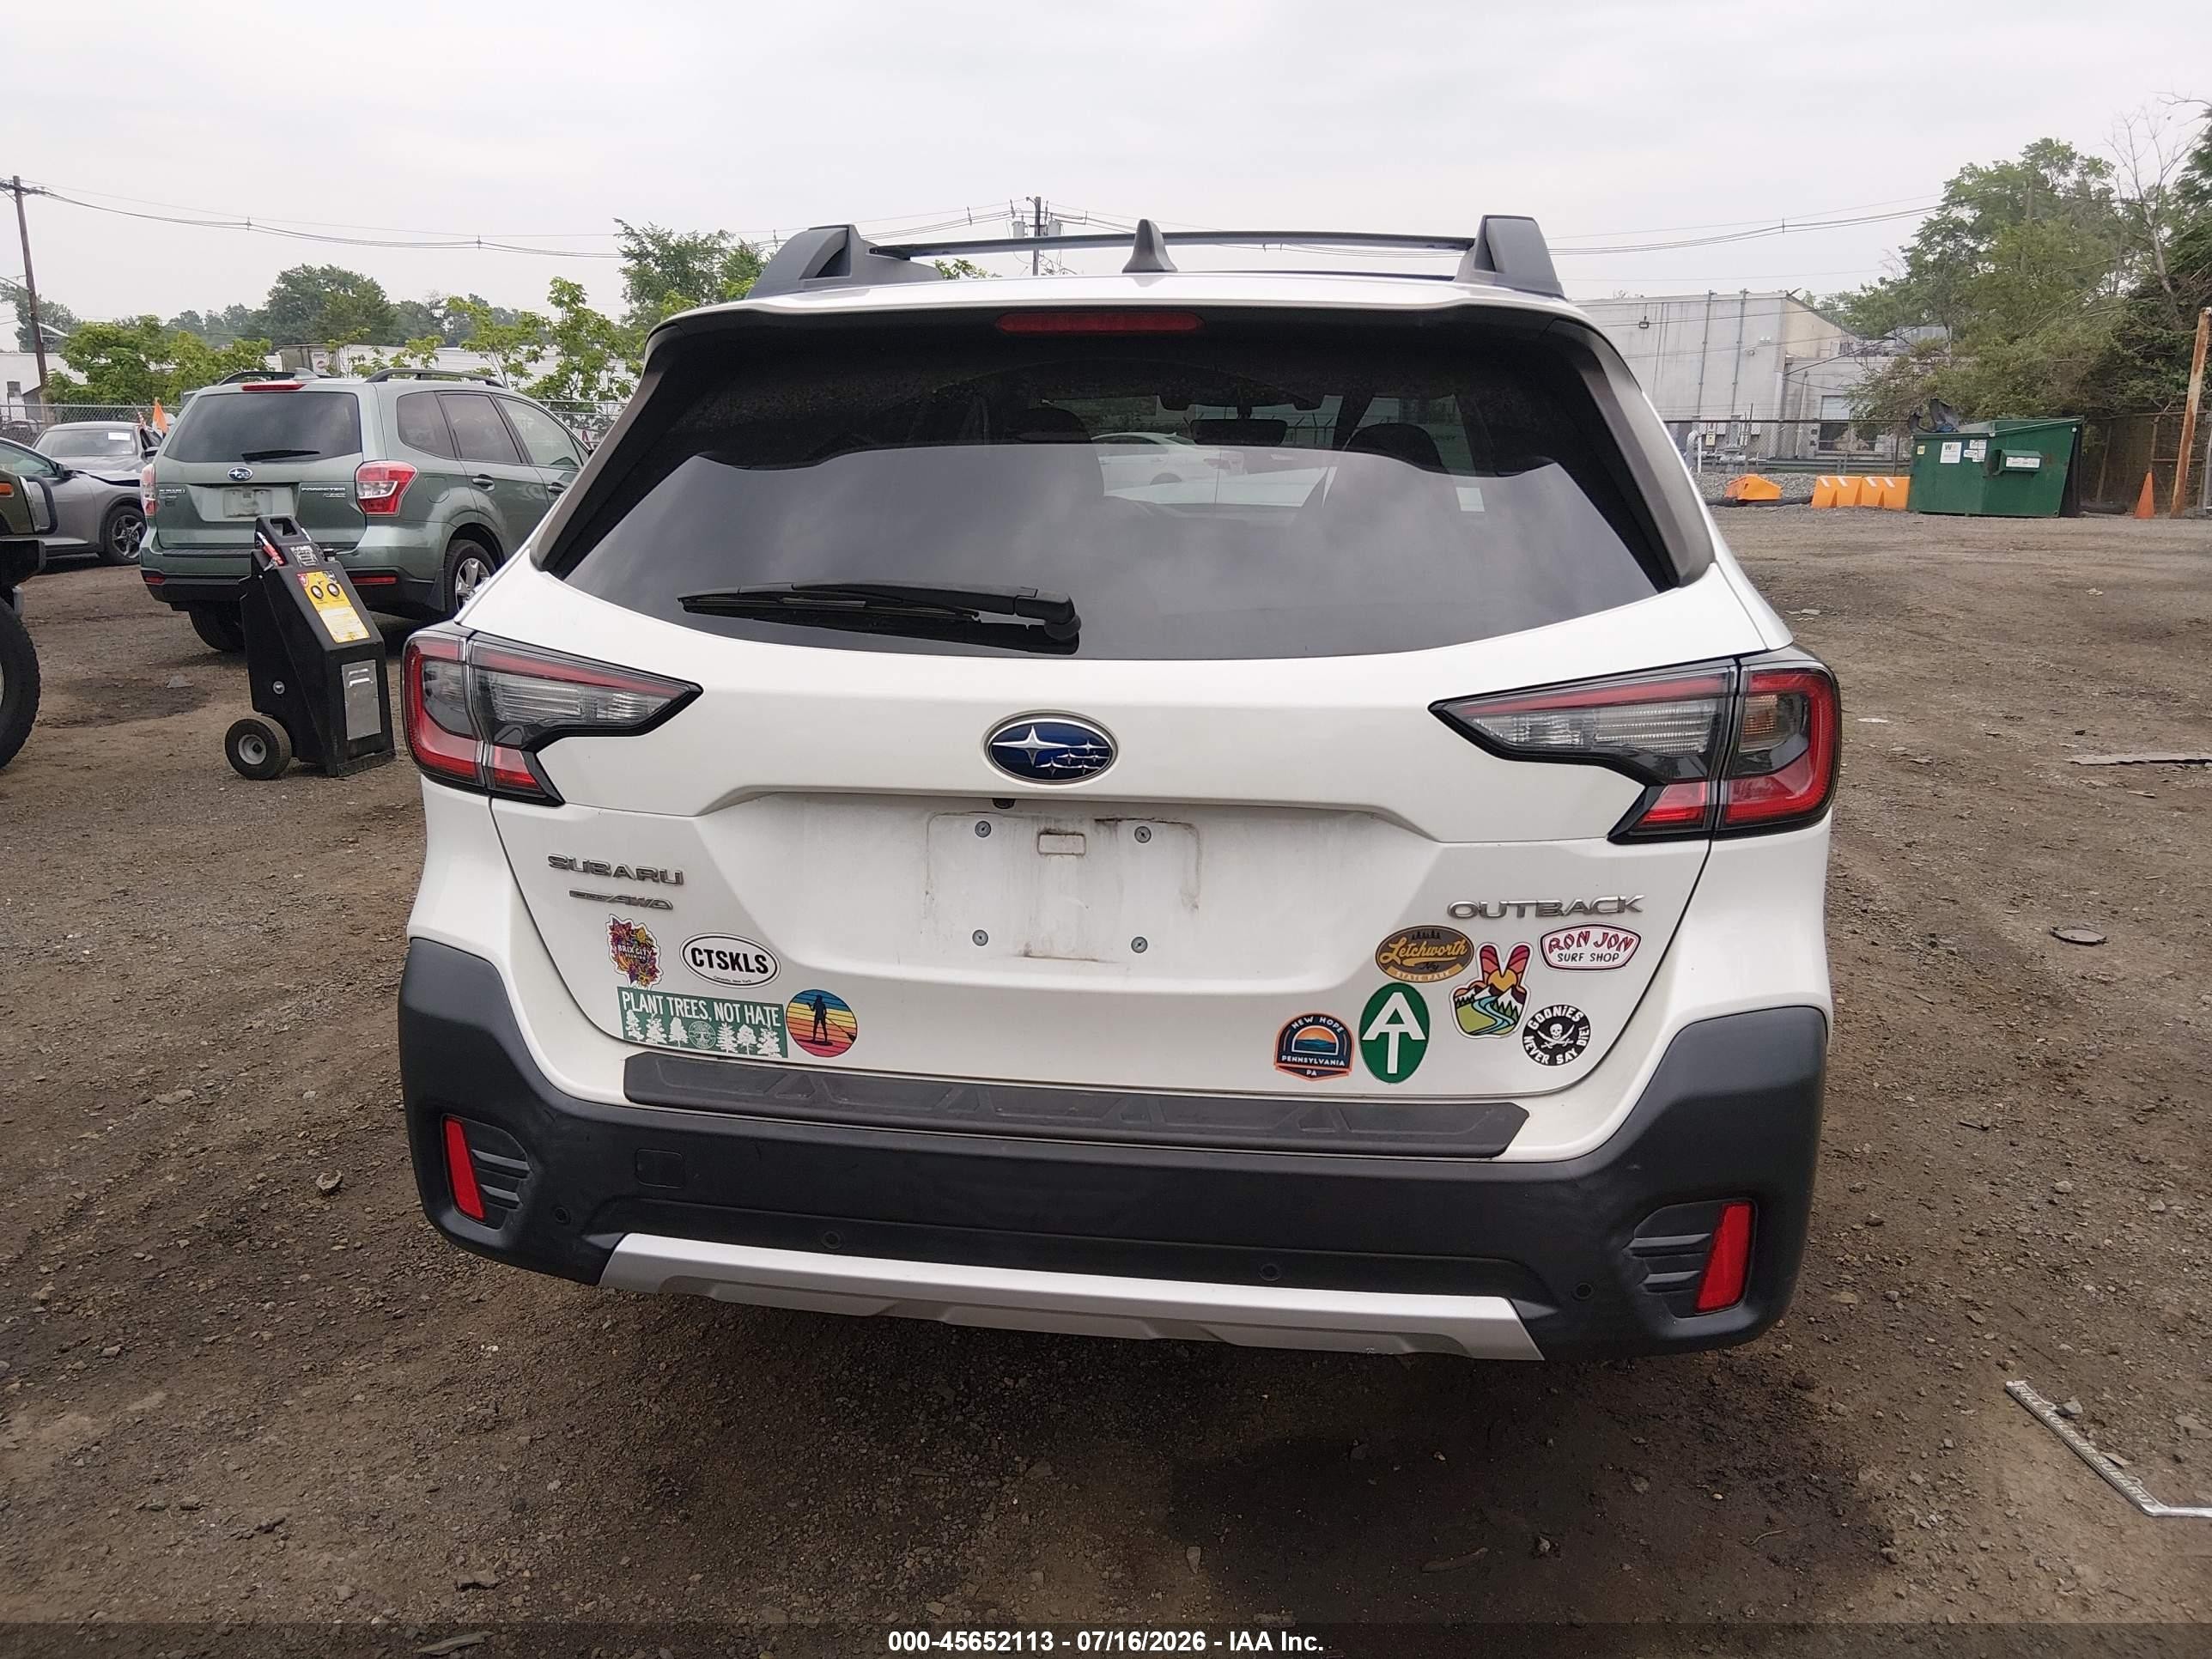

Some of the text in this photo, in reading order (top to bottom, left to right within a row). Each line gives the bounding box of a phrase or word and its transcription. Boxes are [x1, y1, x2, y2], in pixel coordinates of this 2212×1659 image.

[548, 854, 684, 885] SUBARU
[1447, 895, 1645, 919] OUTBACK
[618, 945, 653, 957] BRIX CITY
[1379, 937, 1468, 964] Letchworth
[1547, 931, 1634, 954] RON JON
[690, 947, 769, 975] CTSKLS
[1557, 952, 1620, 963] SURF SHOP
[622, 991, 781, 1027] PLANT TREES, NOT HATE
[1291, 1016, 1345, 1033] NEW HOPE
[1281, 1055, 1346, 1066] PENNSYLVANIA
[1524, 1036, 1550, 1064] NEVER
[1556, 1048, 1577, 1064] SAY
[2013, 1386, 2043, 1407] BILL
[2094, 1456, 2154, 1503] SUBARU
